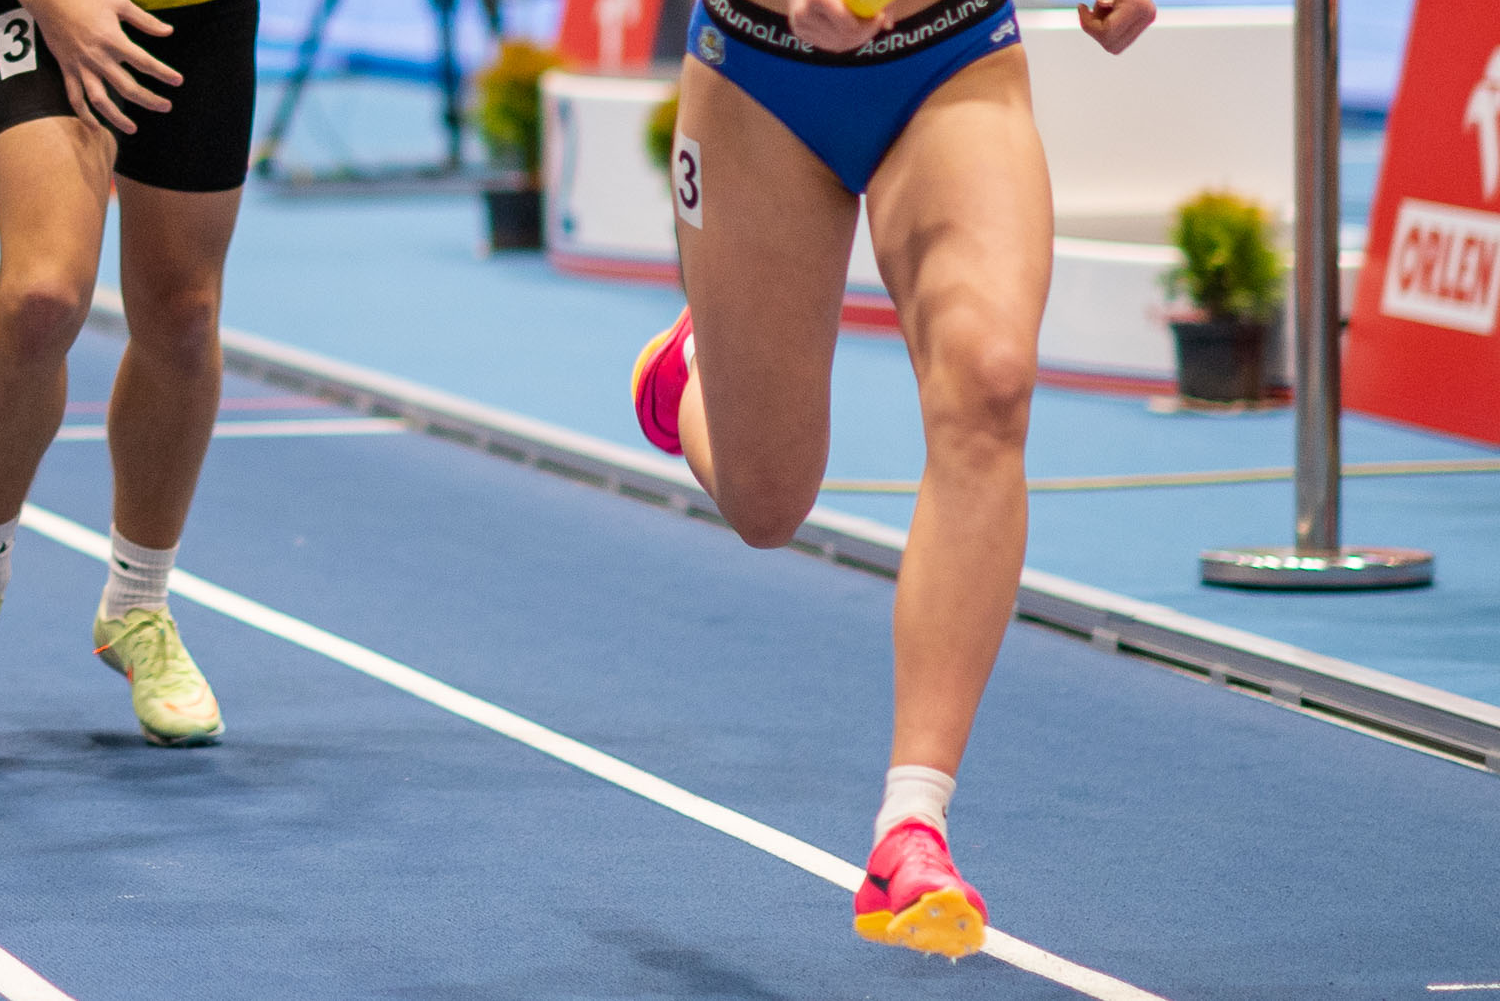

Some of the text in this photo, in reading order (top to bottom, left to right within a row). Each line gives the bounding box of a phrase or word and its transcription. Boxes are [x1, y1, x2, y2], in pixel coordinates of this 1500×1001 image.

[3, 18, 32, 63] 3
[678, 149, 699, 210] 3
[1399, 224, 1498, 305] ORLEN
